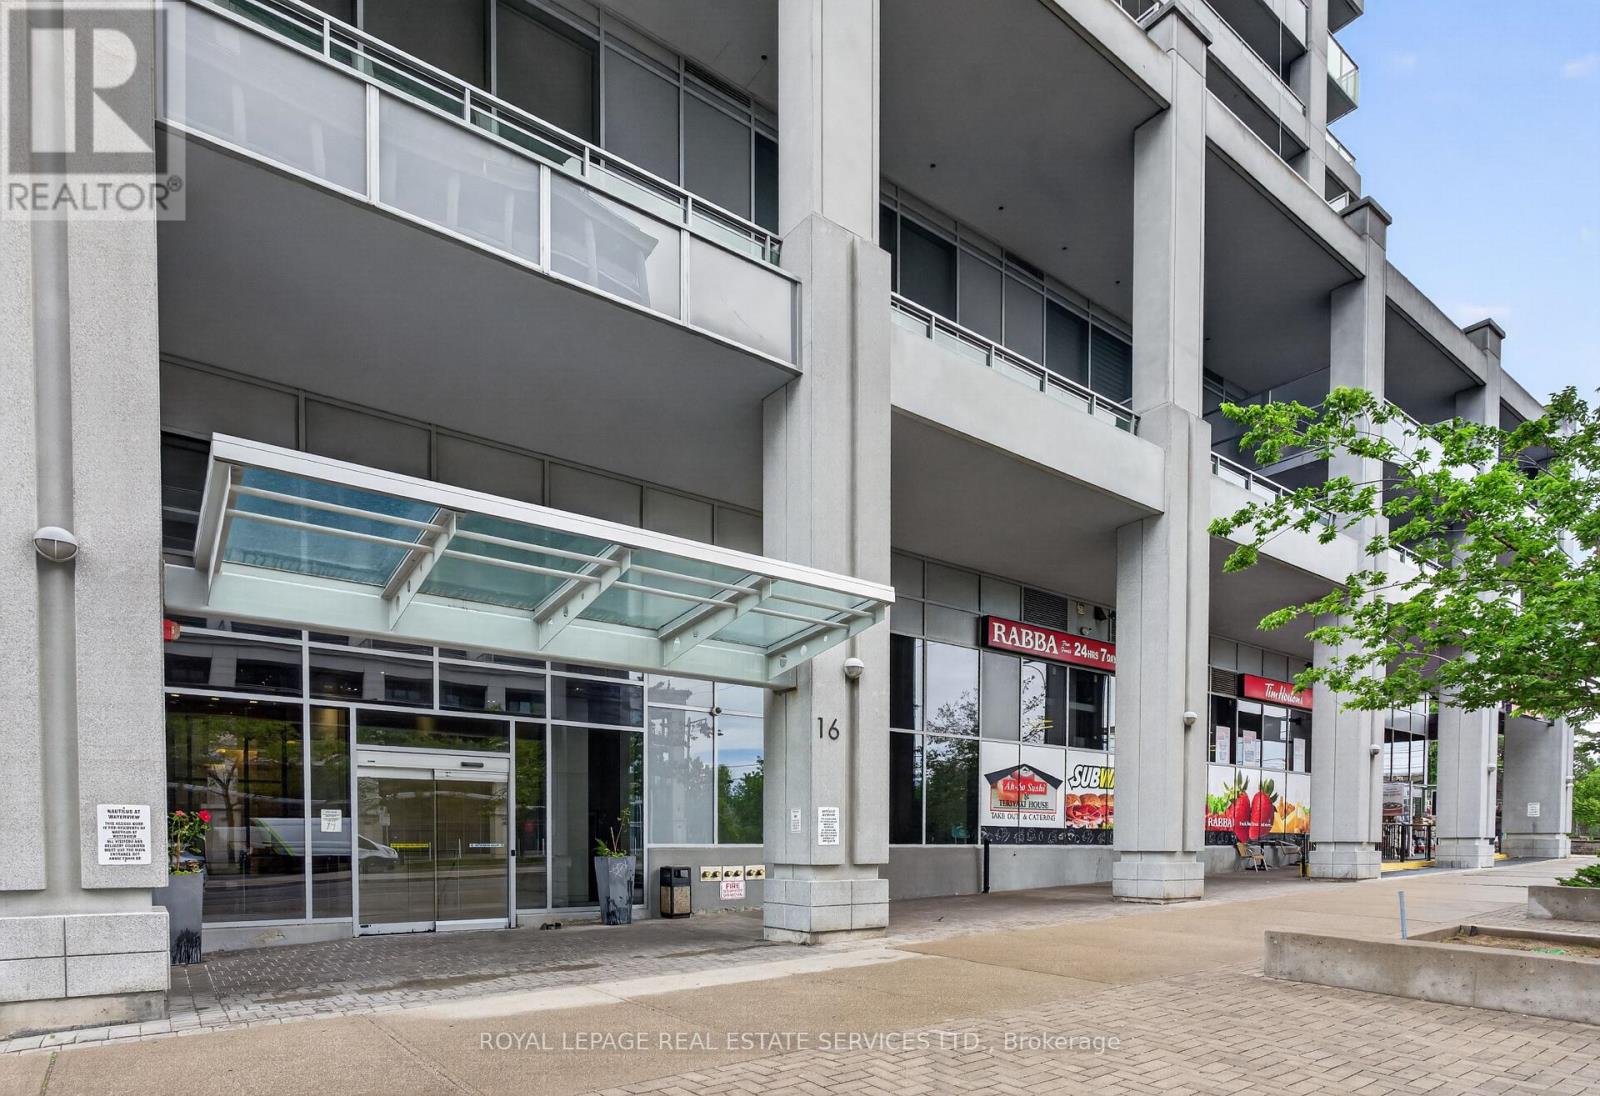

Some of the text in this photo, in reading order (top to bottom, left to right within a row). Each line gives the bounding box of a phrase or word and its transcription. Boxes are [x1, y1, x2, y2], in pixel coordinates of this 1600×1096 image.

[992, 621, 1059, 655] RABBA
[1265, 683, 1279, 699] Tim
[817, 716, 840, 741] 16
[1027, 782, 1047, 793] Sushi
[1028, 801, 1049, 809] HOUSE
[991, 812, 1006, 820] TAKE
[1028, 814, 1056, 822] CATERING
